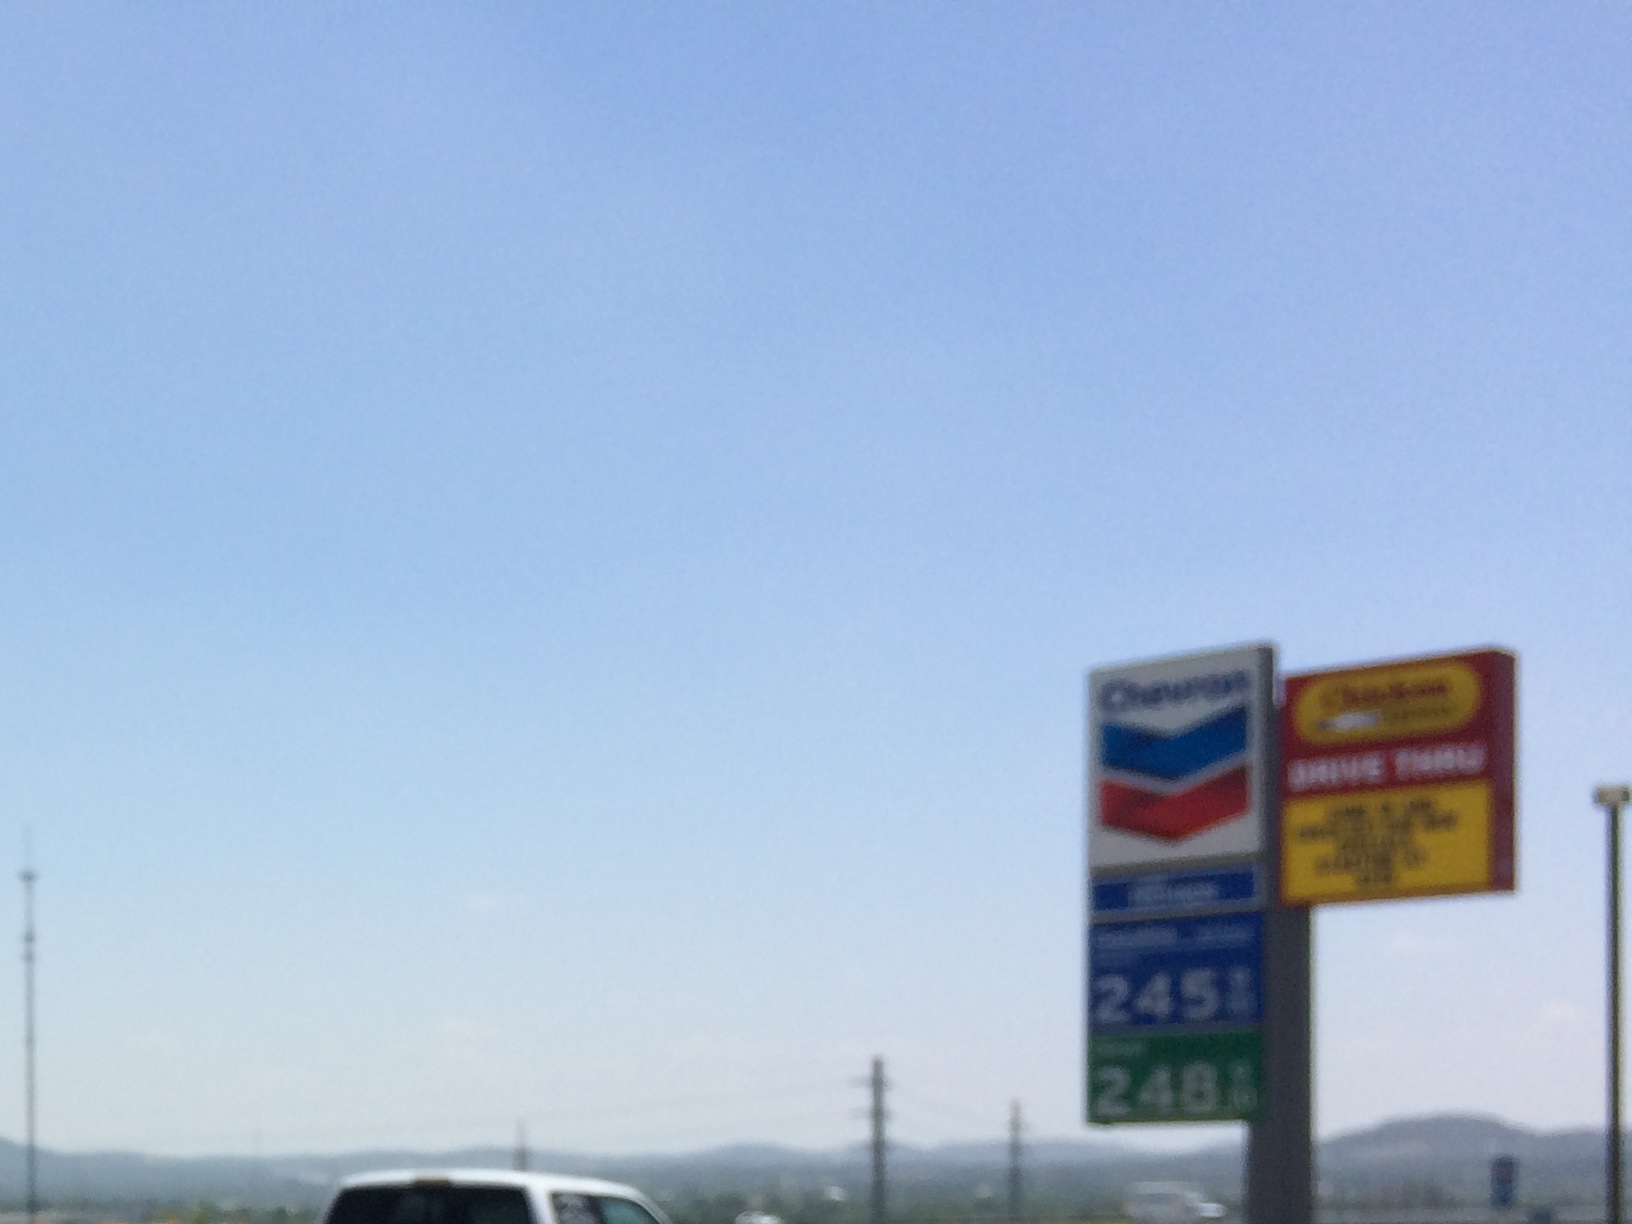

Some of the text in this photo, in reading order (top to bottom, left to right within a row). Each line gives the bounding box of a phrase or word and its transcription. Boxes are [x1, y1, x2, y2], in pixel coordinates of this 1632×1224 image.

[1099, 669, 1250, 712] Chevron
[1287, 743, 1488, 792] DRIVE THRU
